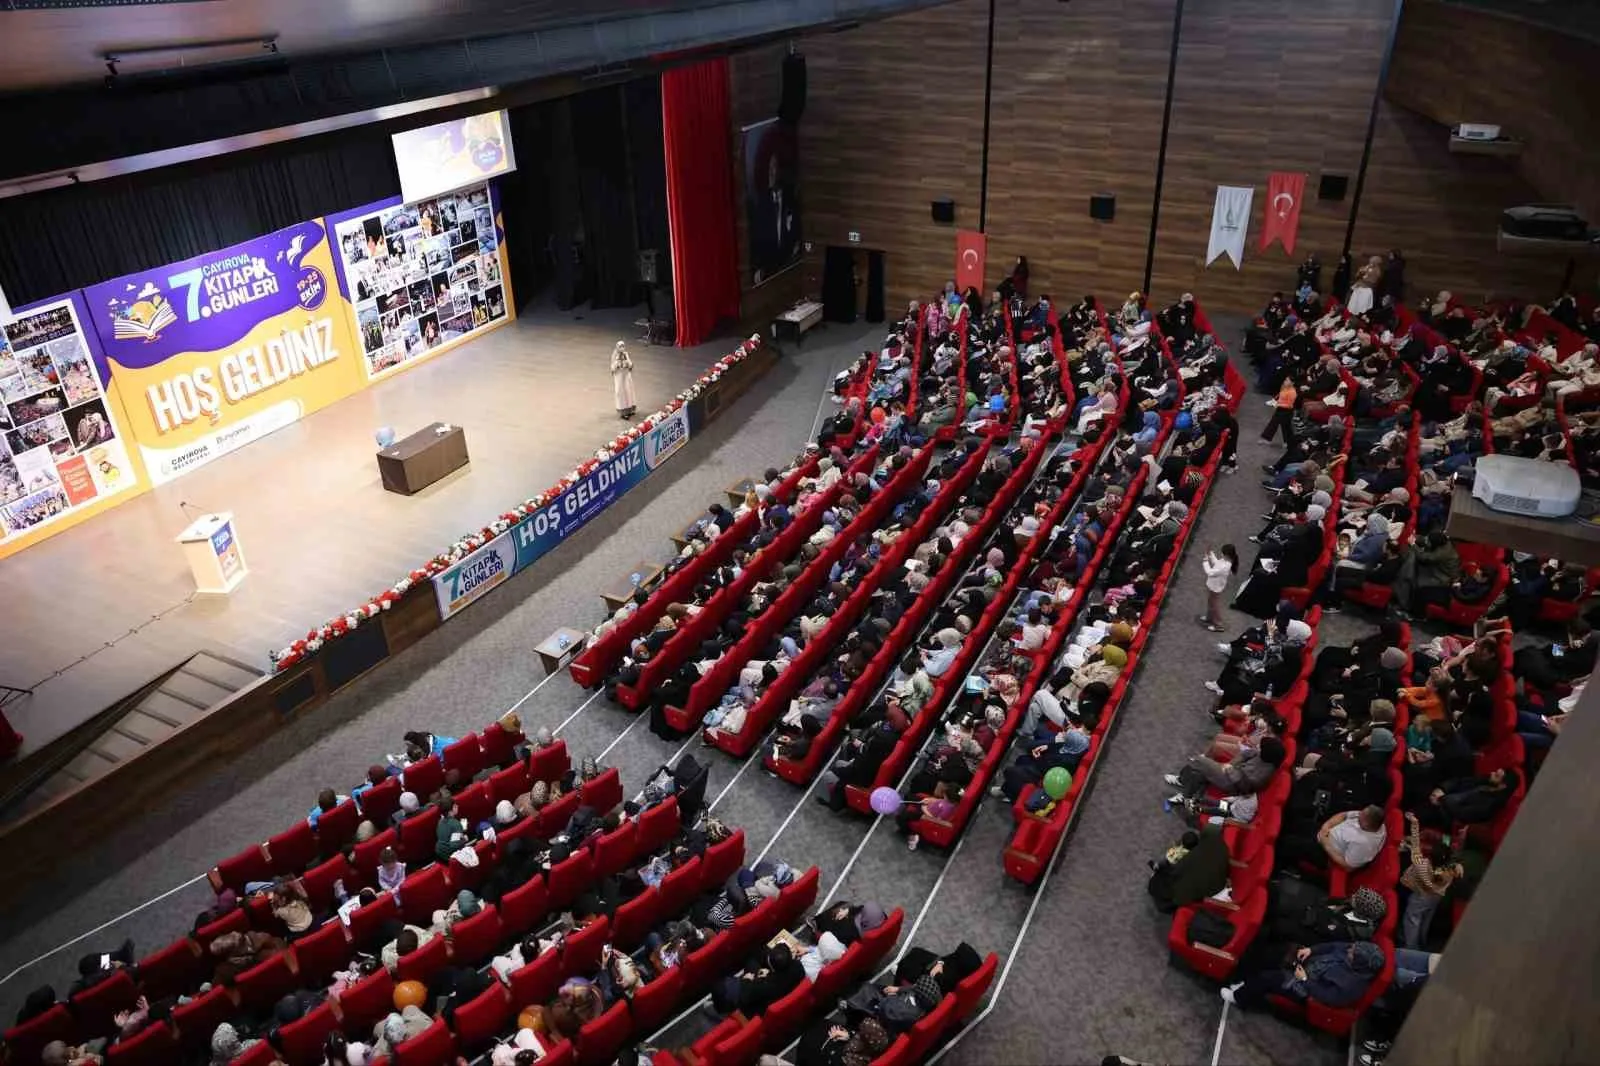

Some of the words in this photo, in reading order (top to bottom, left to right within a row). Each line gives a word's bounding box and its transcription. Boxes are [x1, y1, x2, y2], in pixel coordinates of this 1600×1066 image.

[146, 367, 221, 434] HOŞ
[220, 317, 338, 405] GELDİNİZ
[519, 503, 561, 547] HOŞ
[564, 445, 640, 515] GELDİNİZ
